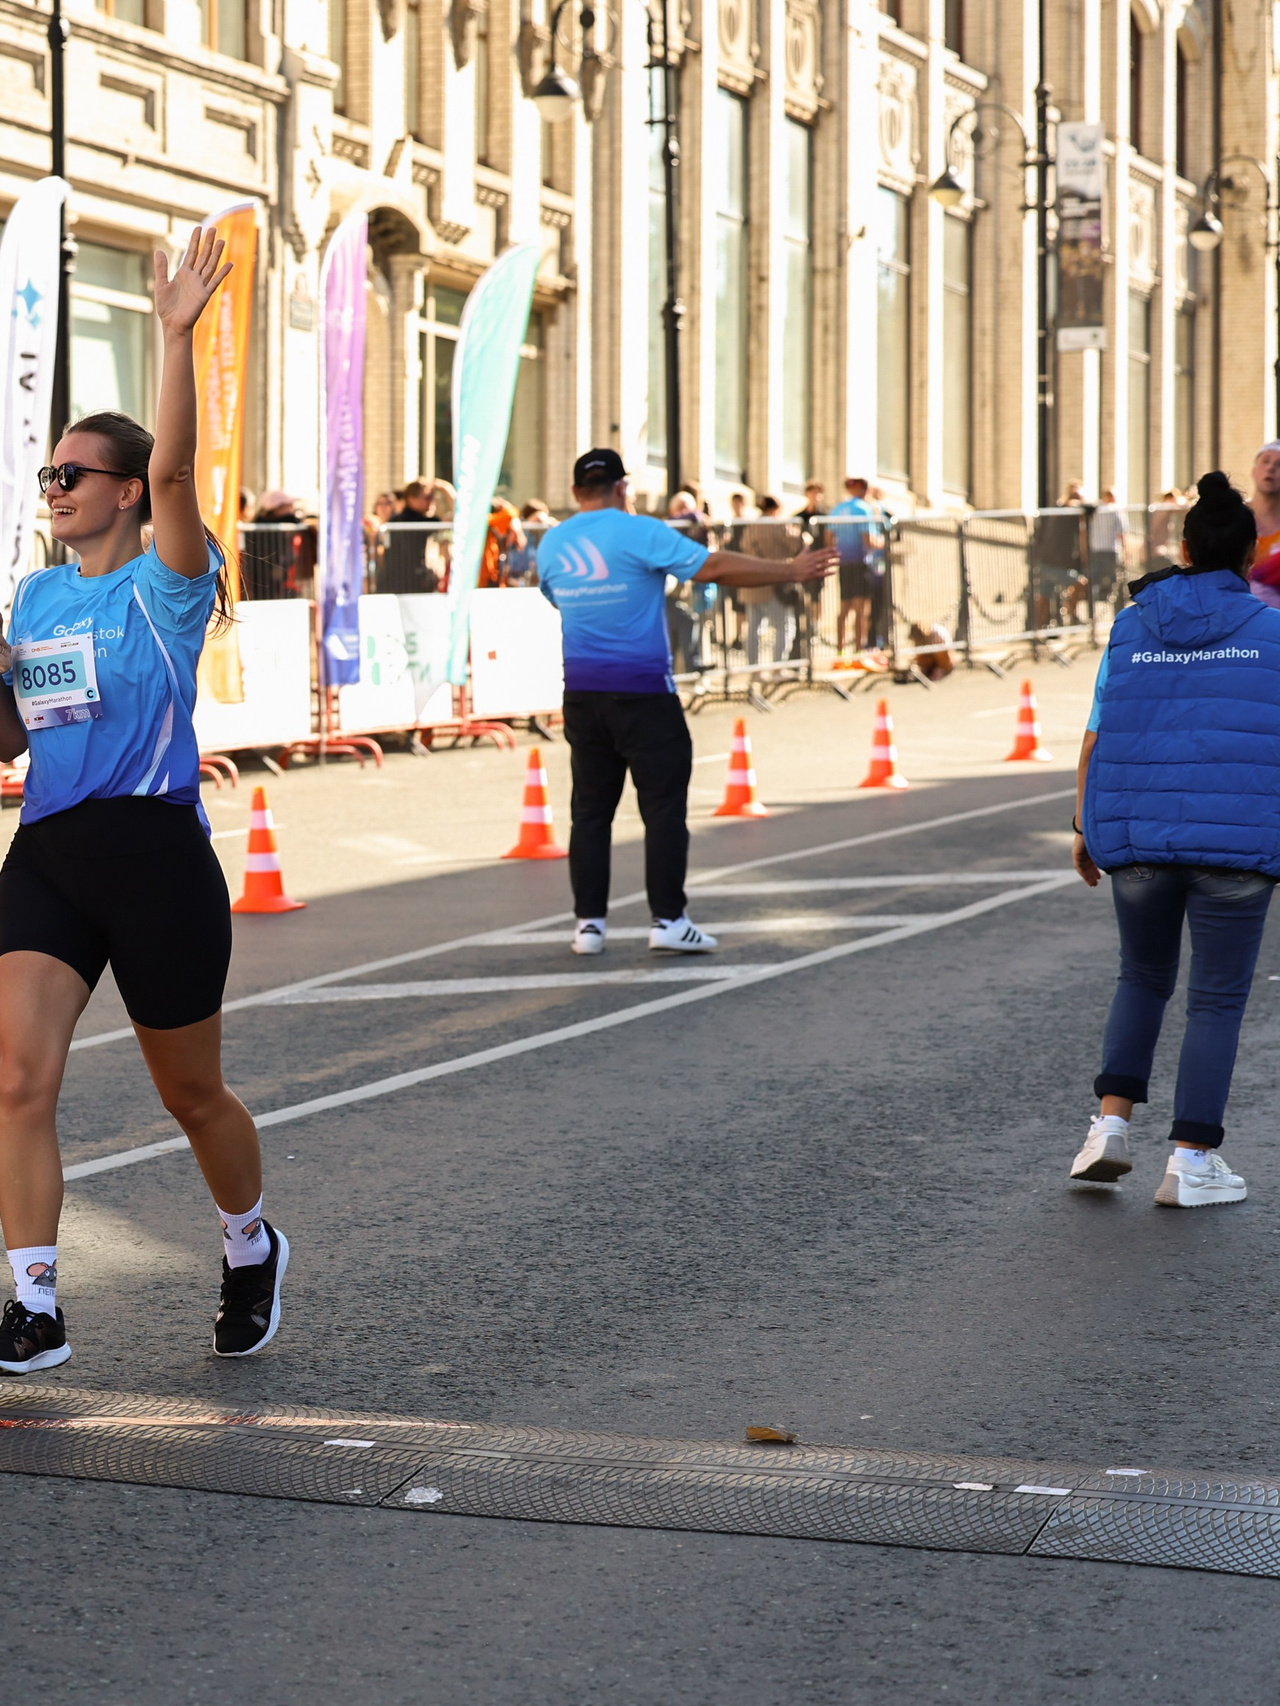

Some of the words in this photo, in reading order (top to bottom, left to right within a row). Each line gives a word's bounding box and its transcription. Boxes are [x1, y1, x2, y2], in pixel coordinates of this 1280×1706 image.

[1131, 646, 1259, 664] #GalaxyMarathon
[21, 660, 76, 690] 8085
[86, 690, 94, 698] C
[32, 696, 73, 706] #GalaxyMarathon
[65, 708, 91, 721] 7km
